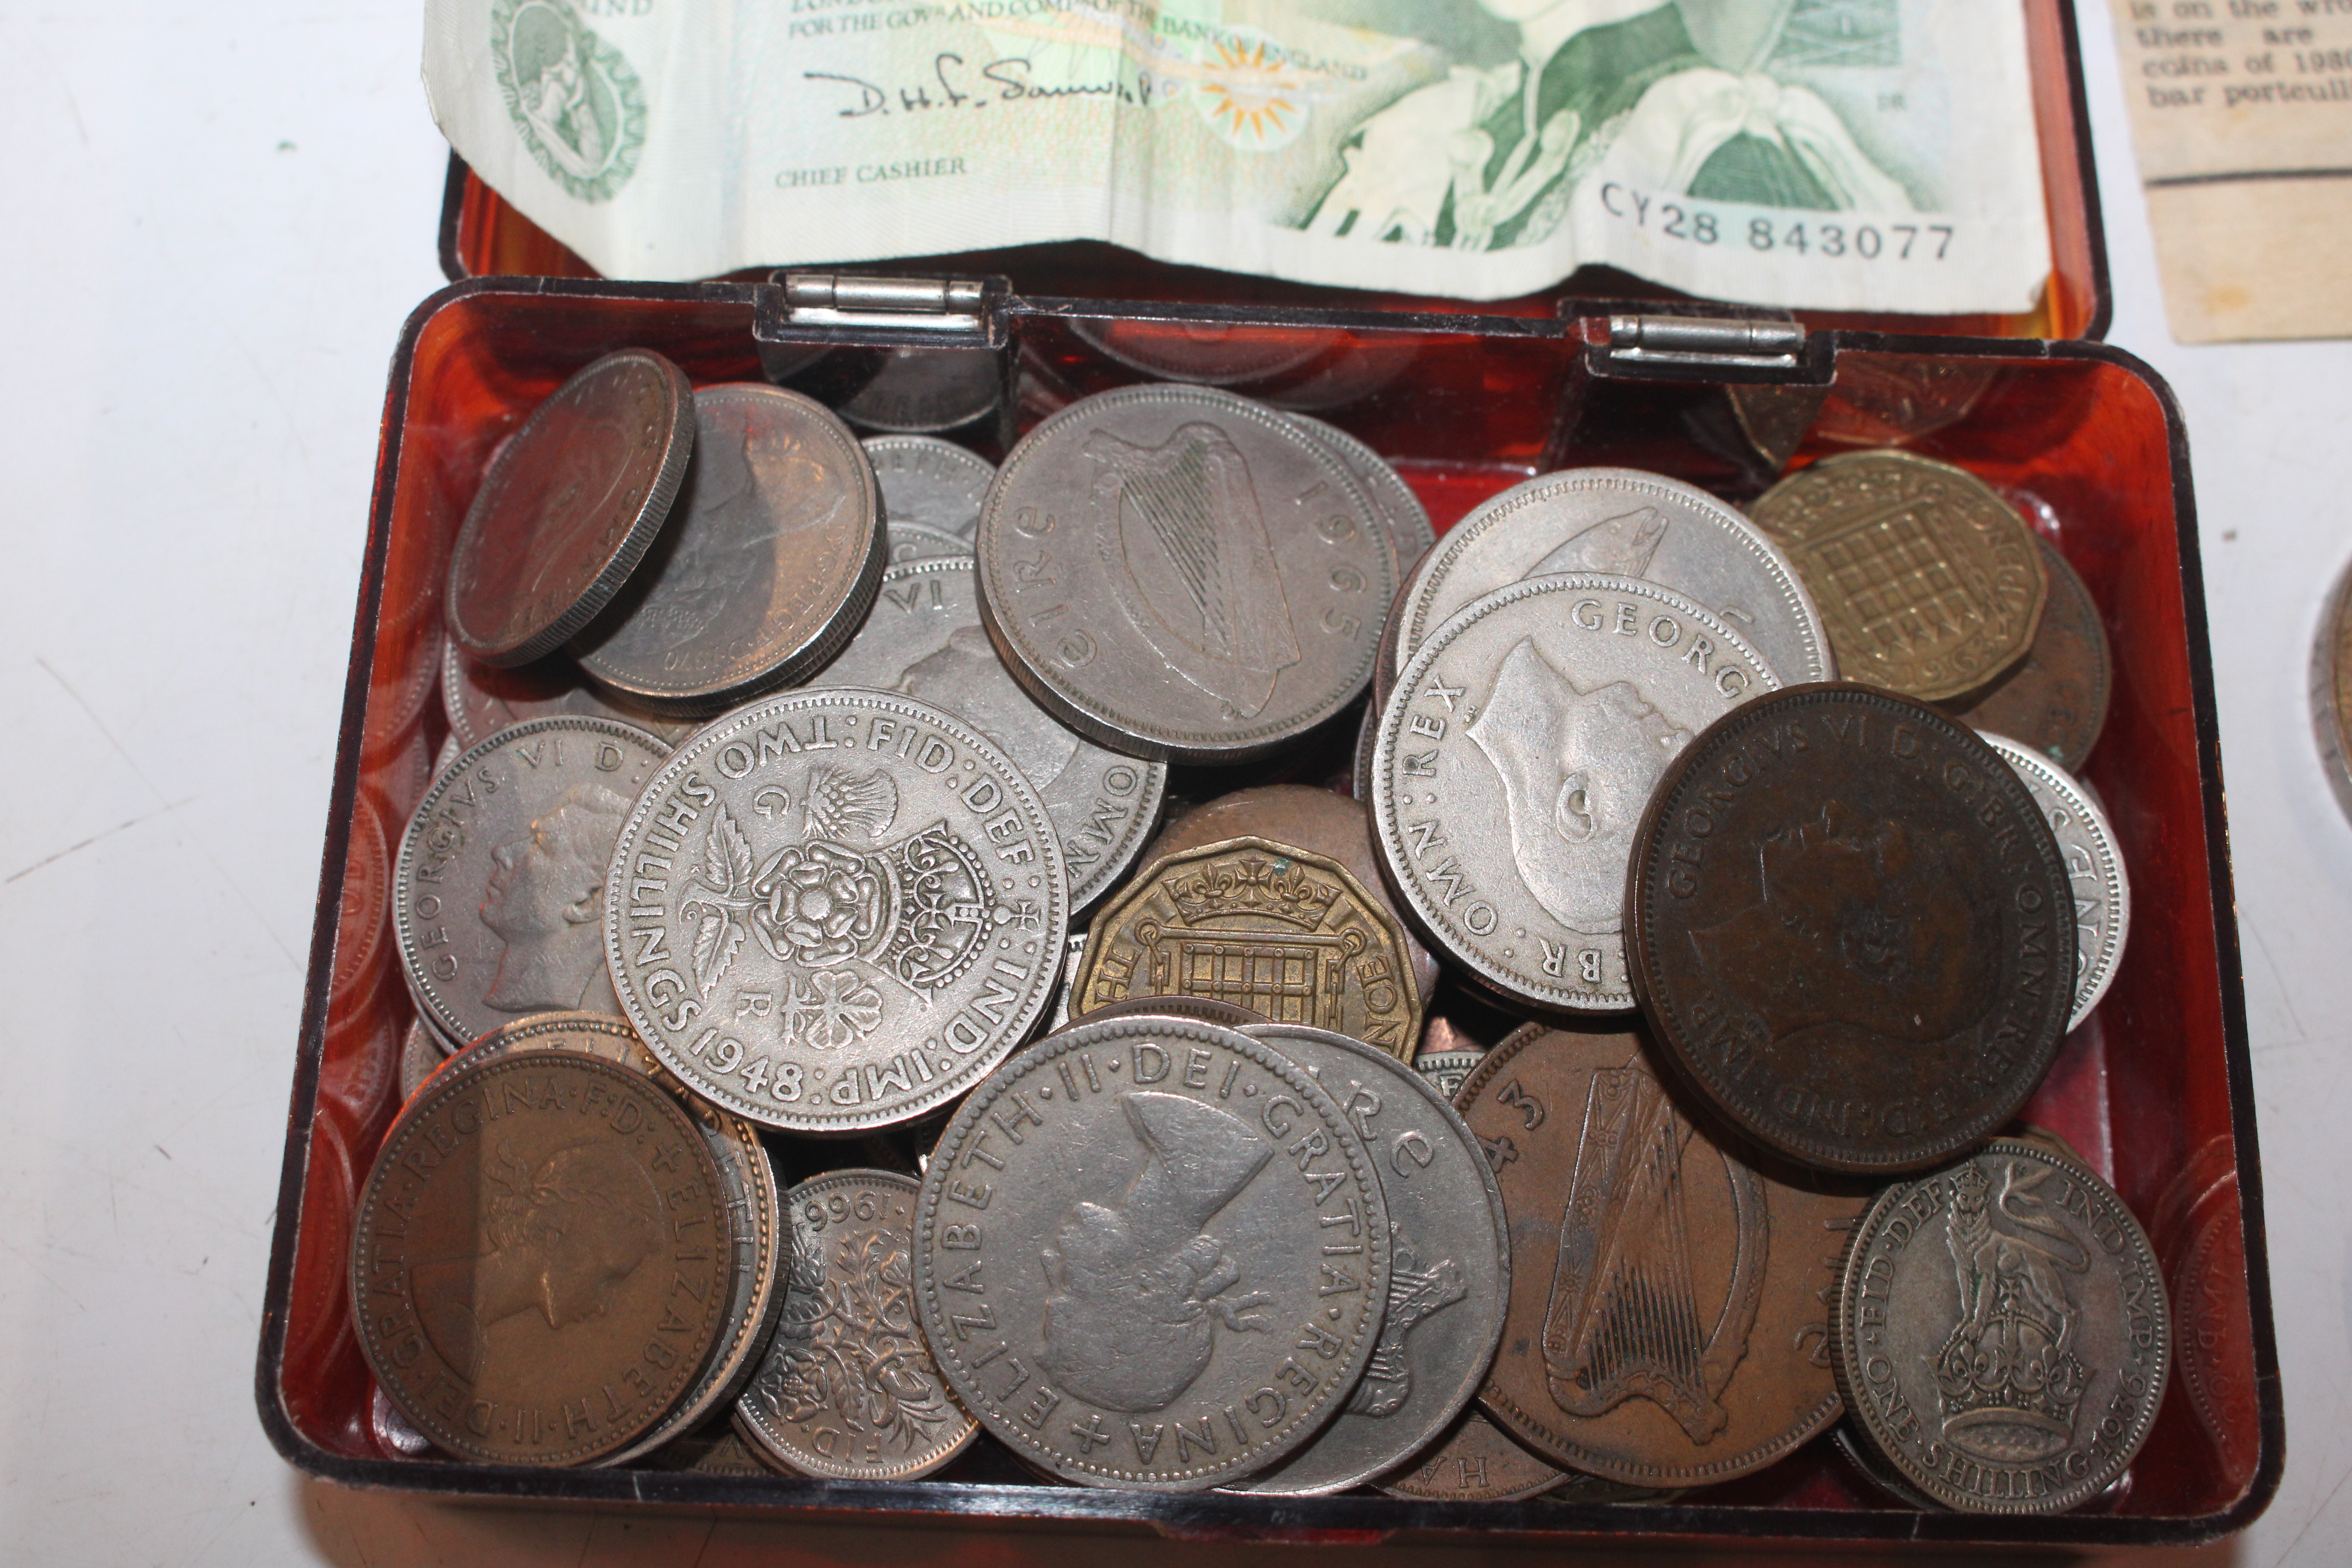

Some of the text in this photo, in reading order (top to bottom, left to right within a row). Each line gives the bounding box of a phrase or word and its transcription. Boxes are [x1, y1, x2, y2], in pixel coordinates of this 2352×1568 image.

[789, 17, 833, 38] FOR
[839, 13, 877, 32] THE
[948, 1, 1004, 21] AND
[2136, 27, 2313, 47] there are
[2245, 51, 2274, 74] of
[2147, 83, 2205, 107] bar
[775, 157, 966, 189] CHIEF CASHIER
[1600, 182, 1954, 260] CY28 843077
[1294, 480, 1368, 643] 1965
[1568, 597, 1752, 702] GEORG
[1402, 674, 1468, 780] REX
[751, 785, 791, 820] G
[1666, 720, 1810, 902] GEORGIVS
[1822, 713, 1869, 748] VI
[415, 767, 500, 982] GEORGIVS
[516, 739, 564, 768] VI
[629, 713, 838, 1103] TWO SHILLINGS 1948
[735, 989, 773, 1020] R
[1357, 953, 1399, 1055] NCE
[403, 1074, 567, 1182] REGINA
[1482, 1078, 1545, 1175] 43
[805, 1190, 891, 1232] 1966
[943, 1042, 1363, 1465] ELIZABETH II DEI GRATIA REGINA
[1860, 1178, 1945, 1329] FID DEF
[372, 1198, 427, 1370] GRATIA
[564, 1185, 706, 1439] ELIZABETH
[2054, 1178, 2154, 1350] IND IMP
[420, 1369, 499, 1437] DEI
[514, 1408, 544, 1445] II
[811, 1426, 884, 1463] FID
[1865, 1353, 2146, 1499] ONE SHILLING 1936
